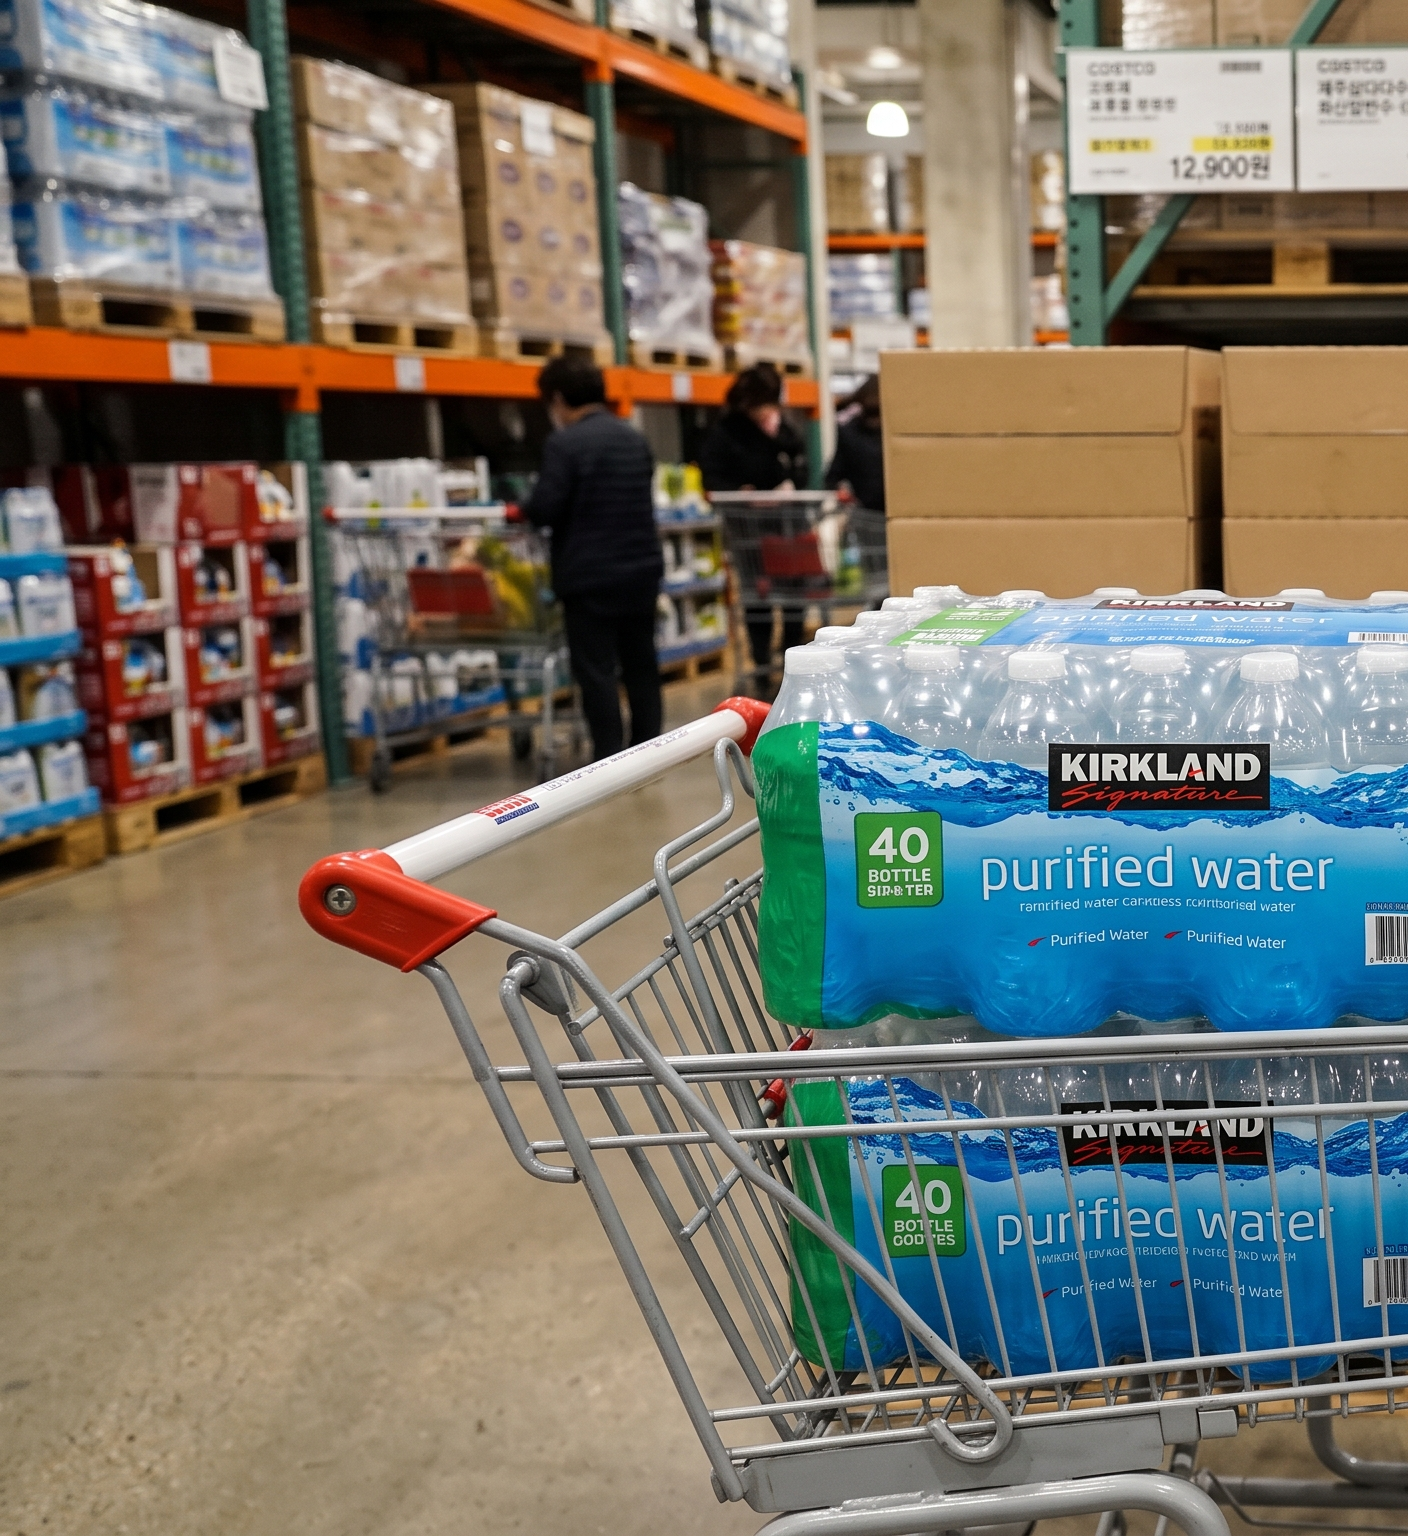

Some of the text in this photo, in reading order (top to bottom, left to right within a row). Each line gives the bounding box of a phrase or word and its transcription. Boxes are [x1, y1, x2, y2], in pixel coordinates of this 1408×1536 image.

[1318, 59, 1385, 73] COSTCO
[1170, 155, 1270, 182] 12,900원
[1211, 614, 1333, 624] water
[1061, 752, 1262, 781] KIRKLAND
[1061, 783, 1263, 811] Signature
[868, 827, 929, 864] 40
[868, 868, 931, 883] BOTTLE
[981, 845, 1334, 901] purified water
[1084, 897, 1119, 909] water
[1260, 901, 1296, 912] water
[1051, 930, 1149, 946] Purified Water
[1246, 936, 1287, 949] Water
[895, 1179, 952, 1214] 40
[1197, 1204, 1335, 1243] water
[1062, 1278, 1115, 1297] Purfied
[1249, 1285, 1285, 1297] Wate
